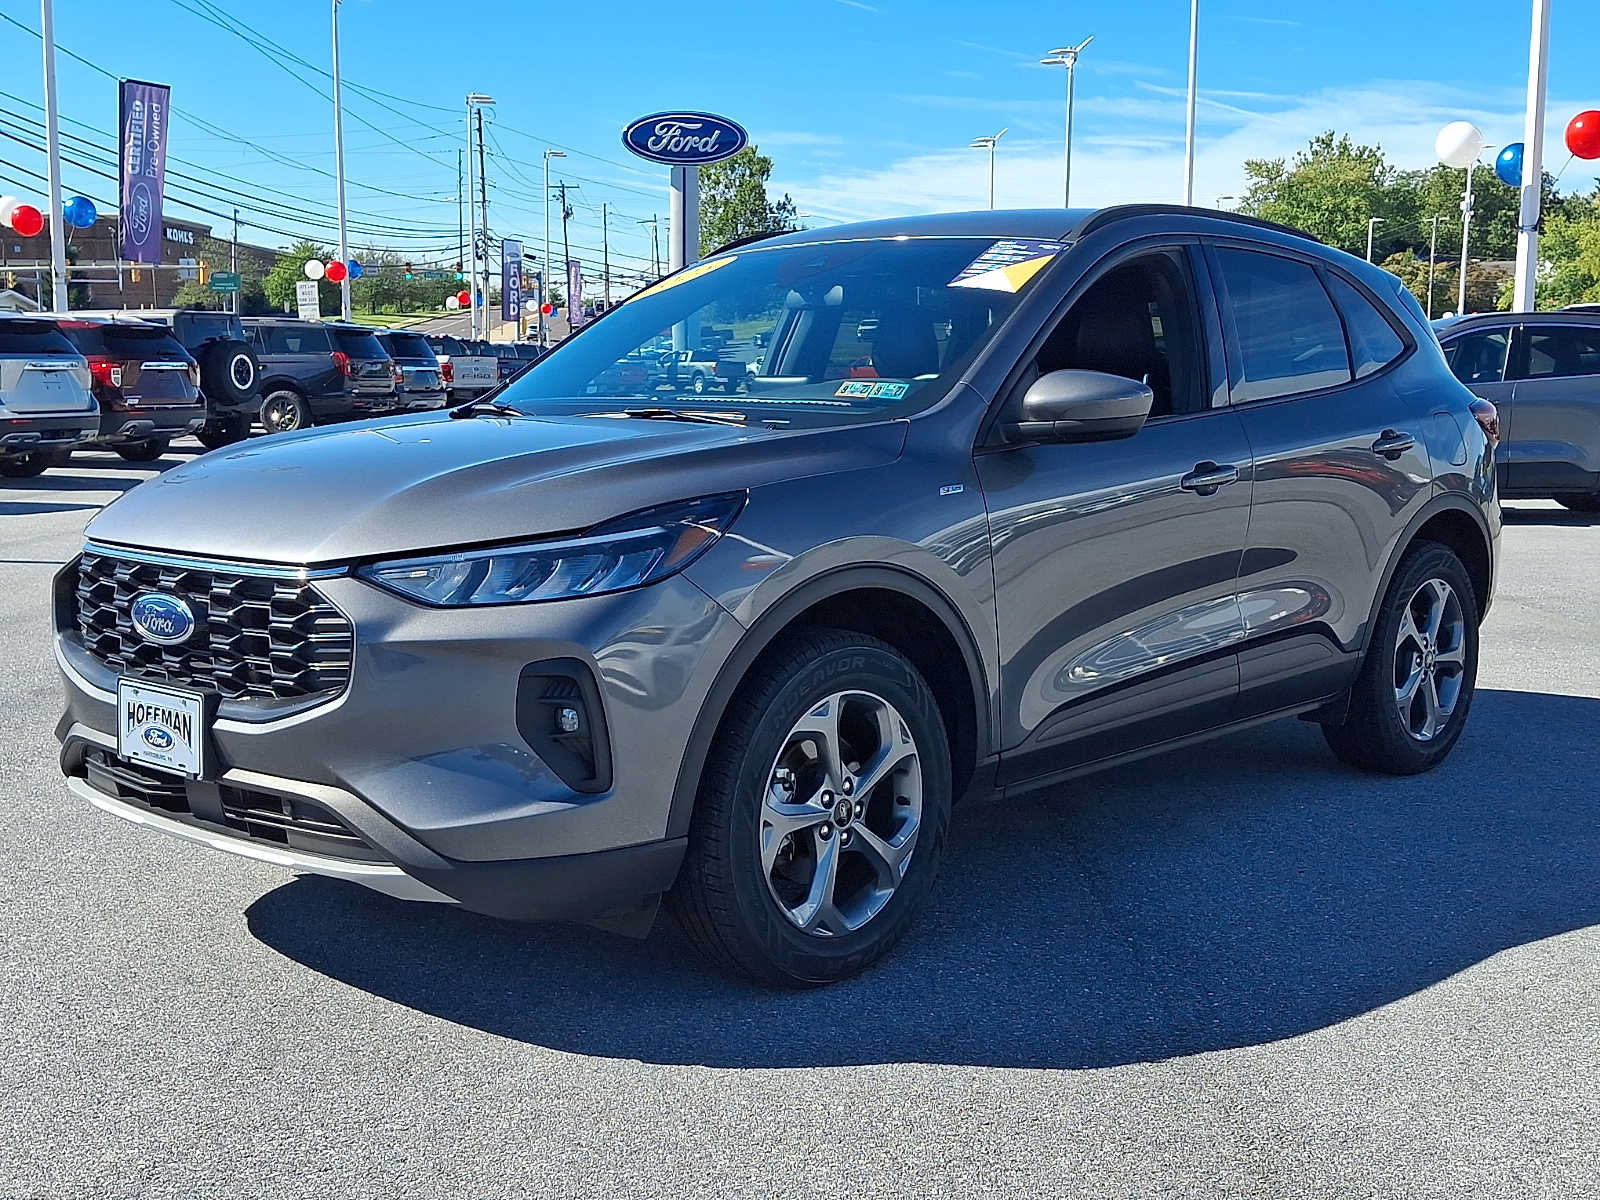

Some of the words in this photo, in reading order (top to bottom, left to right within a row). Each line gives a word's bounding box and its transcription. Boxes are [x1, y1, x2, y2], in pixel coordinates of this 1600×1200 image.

[127, 99, 144, 175] CERTIFIED
[145, 102, 161, 178] Pre-Owned
[647, 121, 721, 152] Ford
[132, 195, 148, 233] Ford
[509, 263, 519, 316] FORD
[141, 604, 176, 634] Ford
[127, 701, 192, 749] HOFFMAN
[148, 729, 169, 748] Ford
